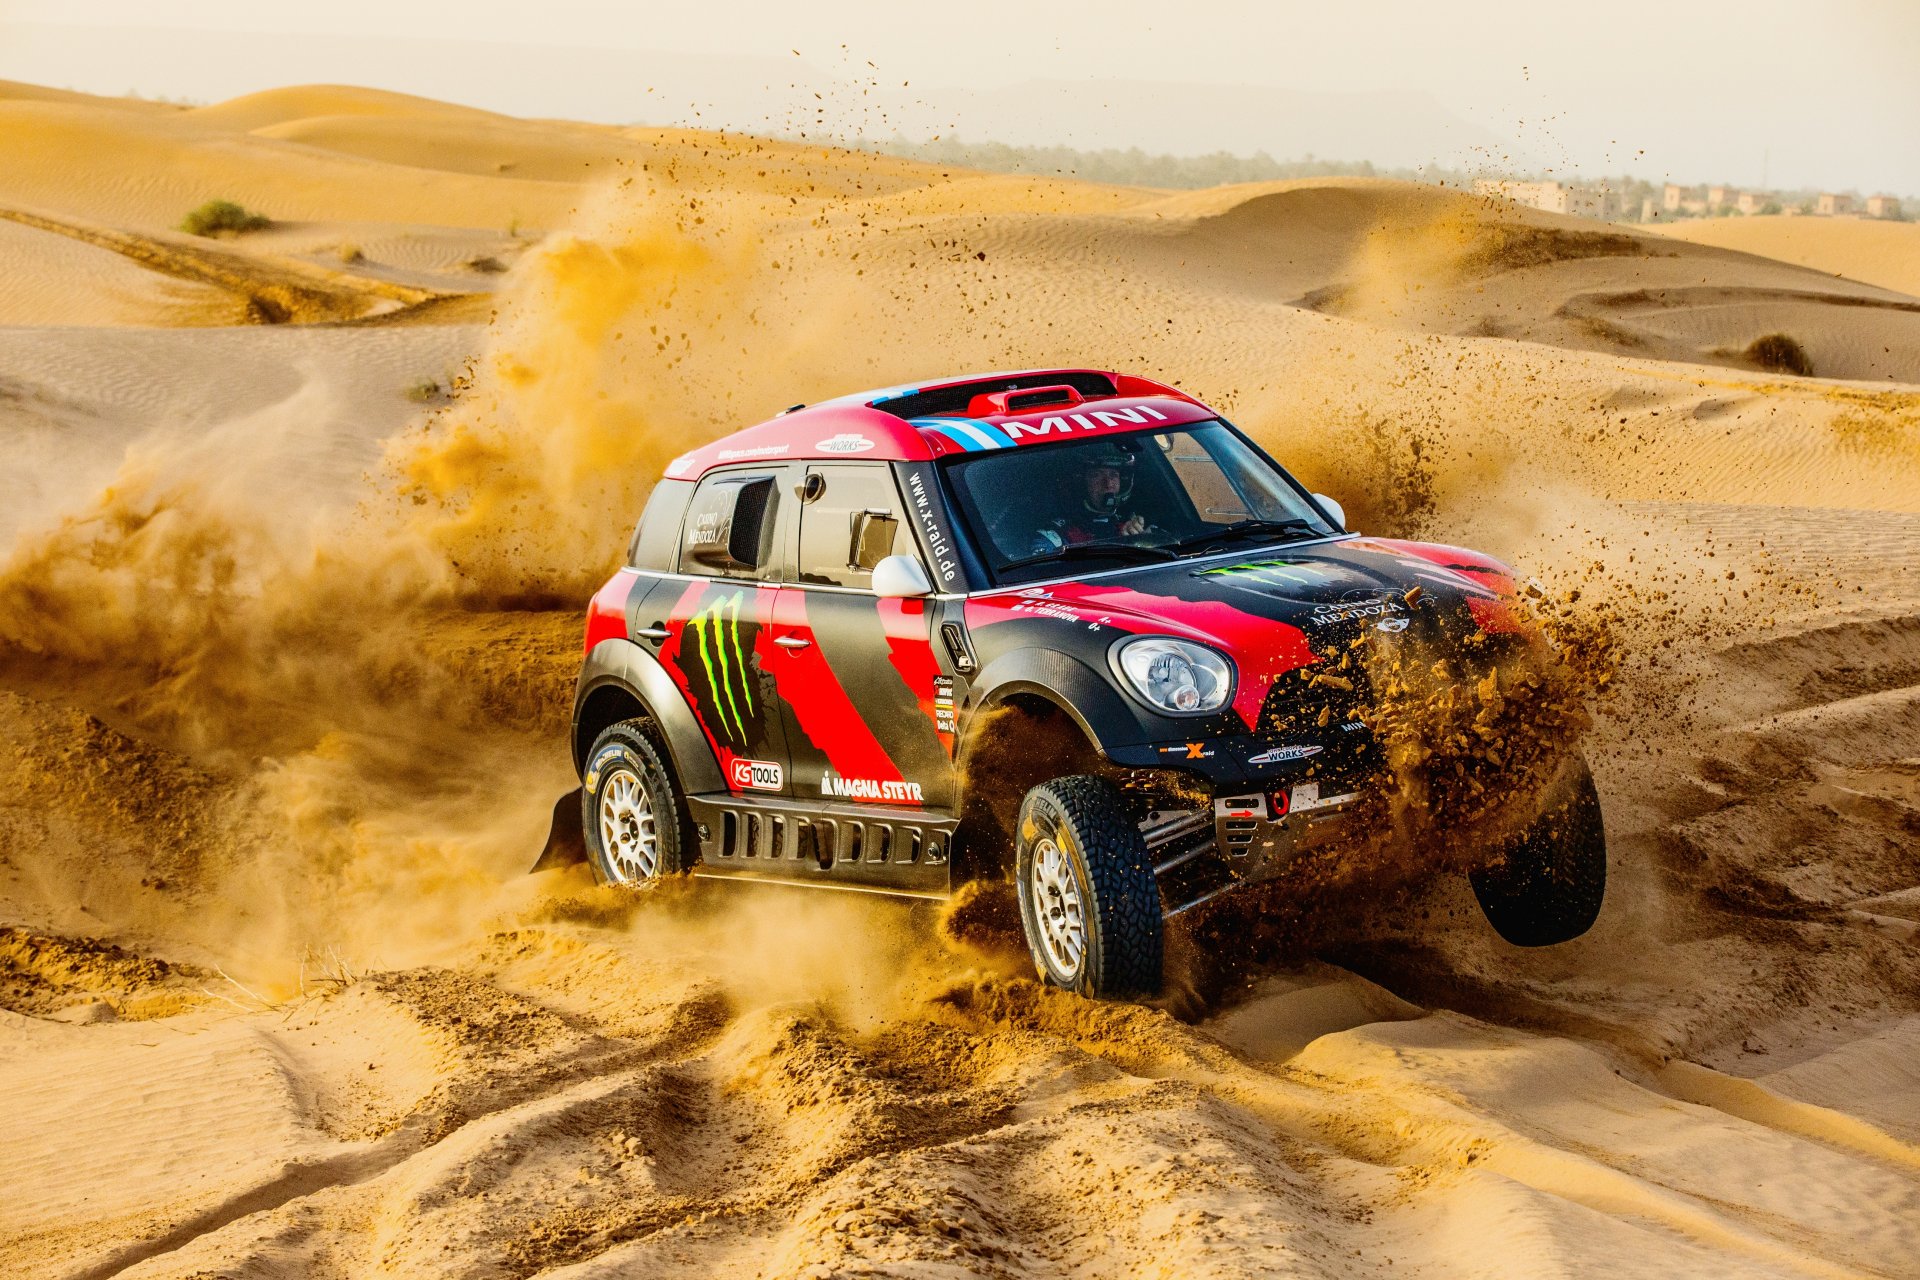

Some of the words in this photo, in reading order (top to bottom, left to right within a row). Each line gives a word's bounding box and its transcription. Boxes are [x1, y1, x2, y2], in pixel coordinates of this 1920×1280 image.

[999, 405, 1168, 439] MINI
[829, 440, 860, 451] WORKS
[909, 471, 956, 582] www.x-raid.de
[1340, 721, 1367, 732] MIN
[1269, 749, 1304, 761] WORKS
[751, 767, 779, 784] TOOLS
[834, 777, 883, 799] MAGNA
[882, 781, 925, 801] STEYR
